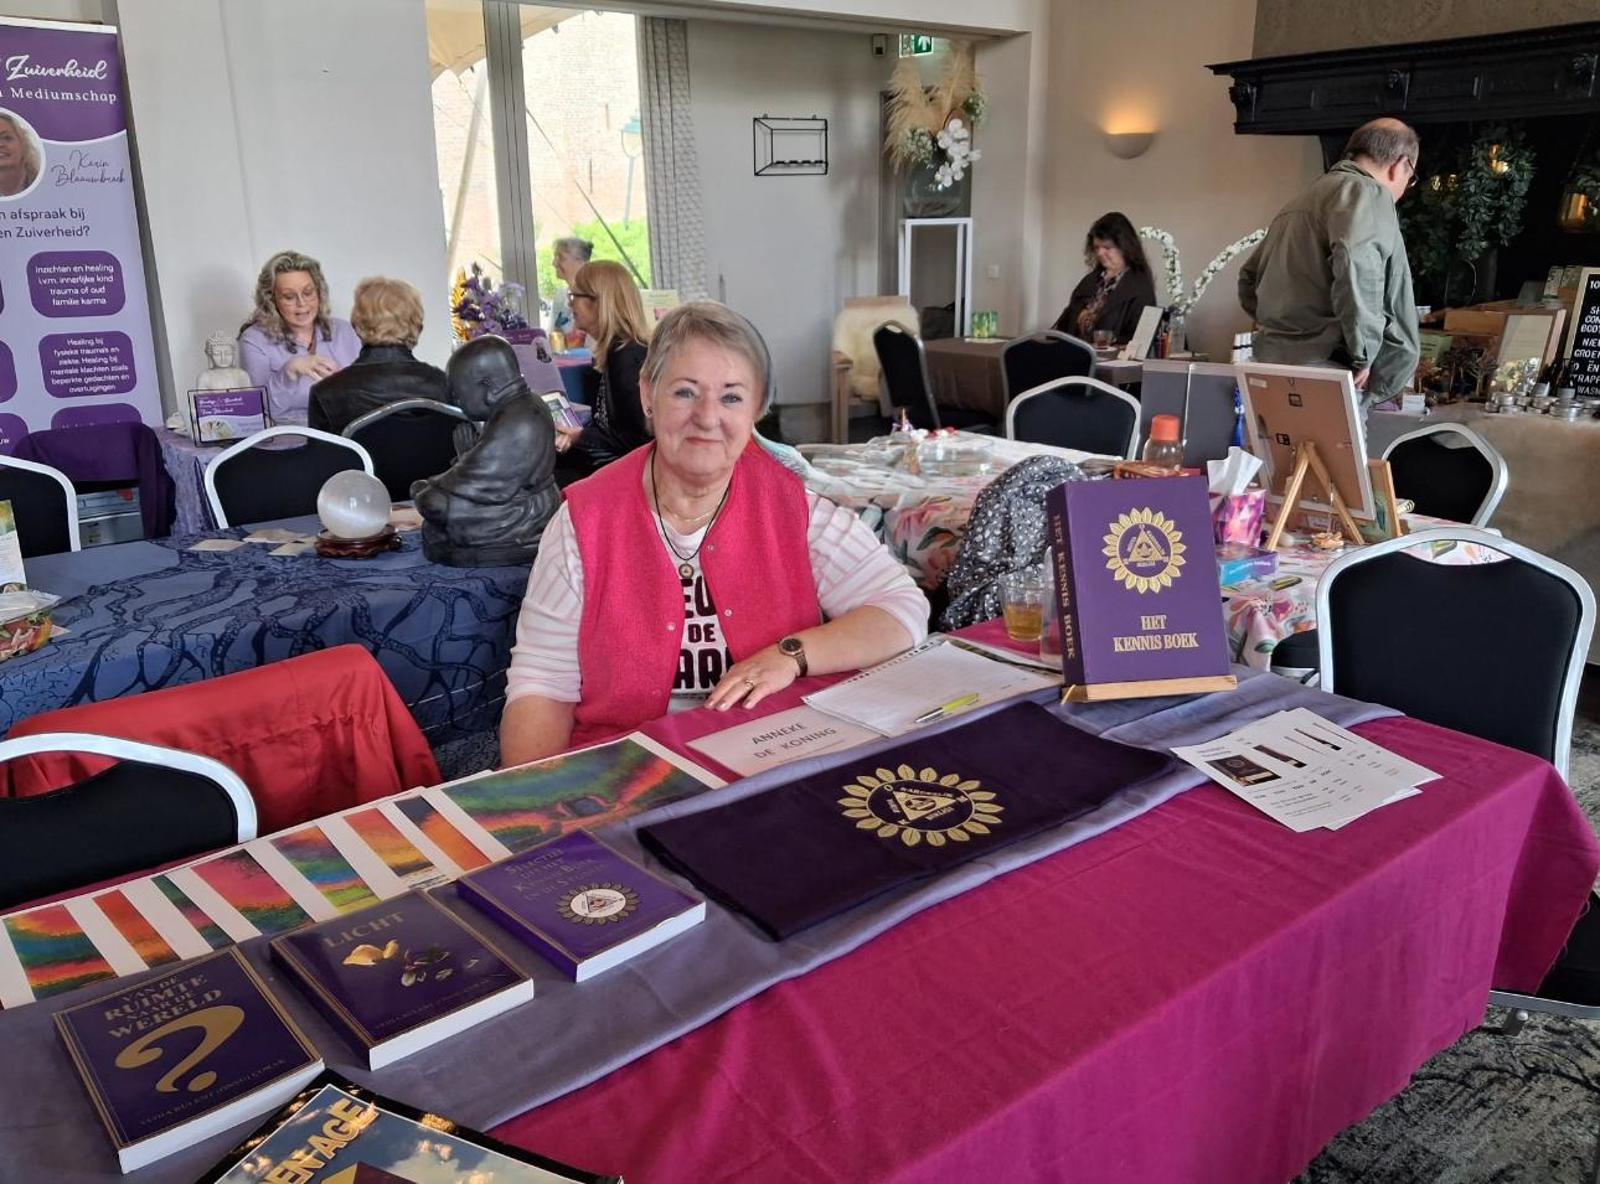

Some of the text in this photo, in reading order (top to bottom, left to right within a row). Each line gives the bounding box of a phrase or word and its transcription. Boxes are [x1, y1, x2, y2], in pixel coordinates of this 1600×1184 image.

[5, 54, 108, 81] Zuiverheid
[10, 87, 117, 105] Mediumschap
[10, 207, 67, 222] afspraak
[69, 207, 85, 221] bij
[15, 225, 90, 238] Zuiverheid?
[73, 265, 84, 273] en
[85, 264, 114, 273] healing
[96, 274, 114, 282] kind
[80, 286, 89, 295] of
[90, 285, 106, 294] oud
[81, 297, 107, 305] karma
[1057, 551, 1070, 608] KENNIS
[688, 623, 717, 643] DE
[1140, 614, 1167, 631] HET
[1063, 613, 1075, 661] BOEK
[1112, 632, 1200, 653] KENNIS BOEK
[752, 722, 808, 745] ANNEKE
[753, 727, 837, 759] DE KONING
[323, 911, 404, 948] LICHT
[104, 974, 208, 1021] RUIMTE
[109, 989, 223, 1038] WERELD
[307, 1097, 380, 1160] AGE
